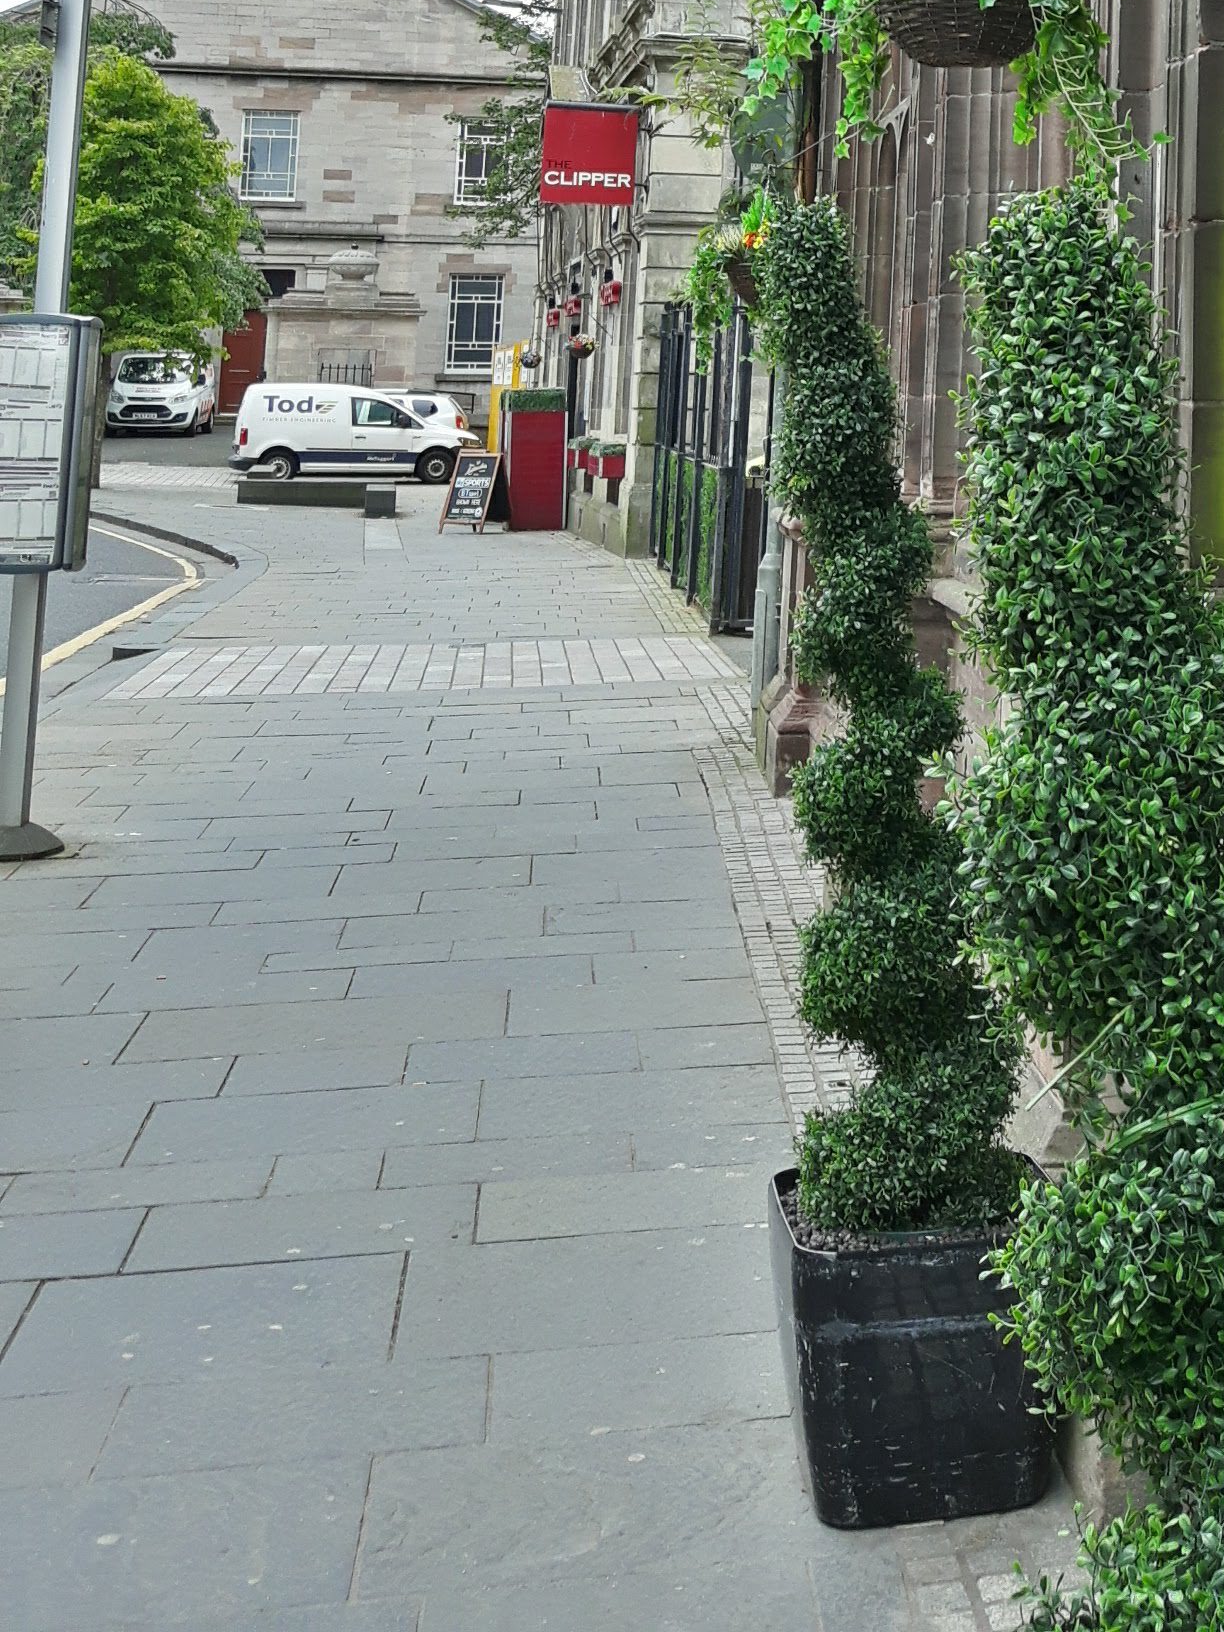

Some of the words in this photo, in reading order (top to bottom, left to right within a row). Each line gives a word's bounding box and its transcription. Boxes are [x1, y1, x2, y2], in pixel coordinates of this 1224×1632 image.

[546, 159, 573, 169] THE
[544, 170, 632, 188] CLIPPER
[263, 395, 314, 414] Tod
[464, 478, 491, 488] SPORTS
